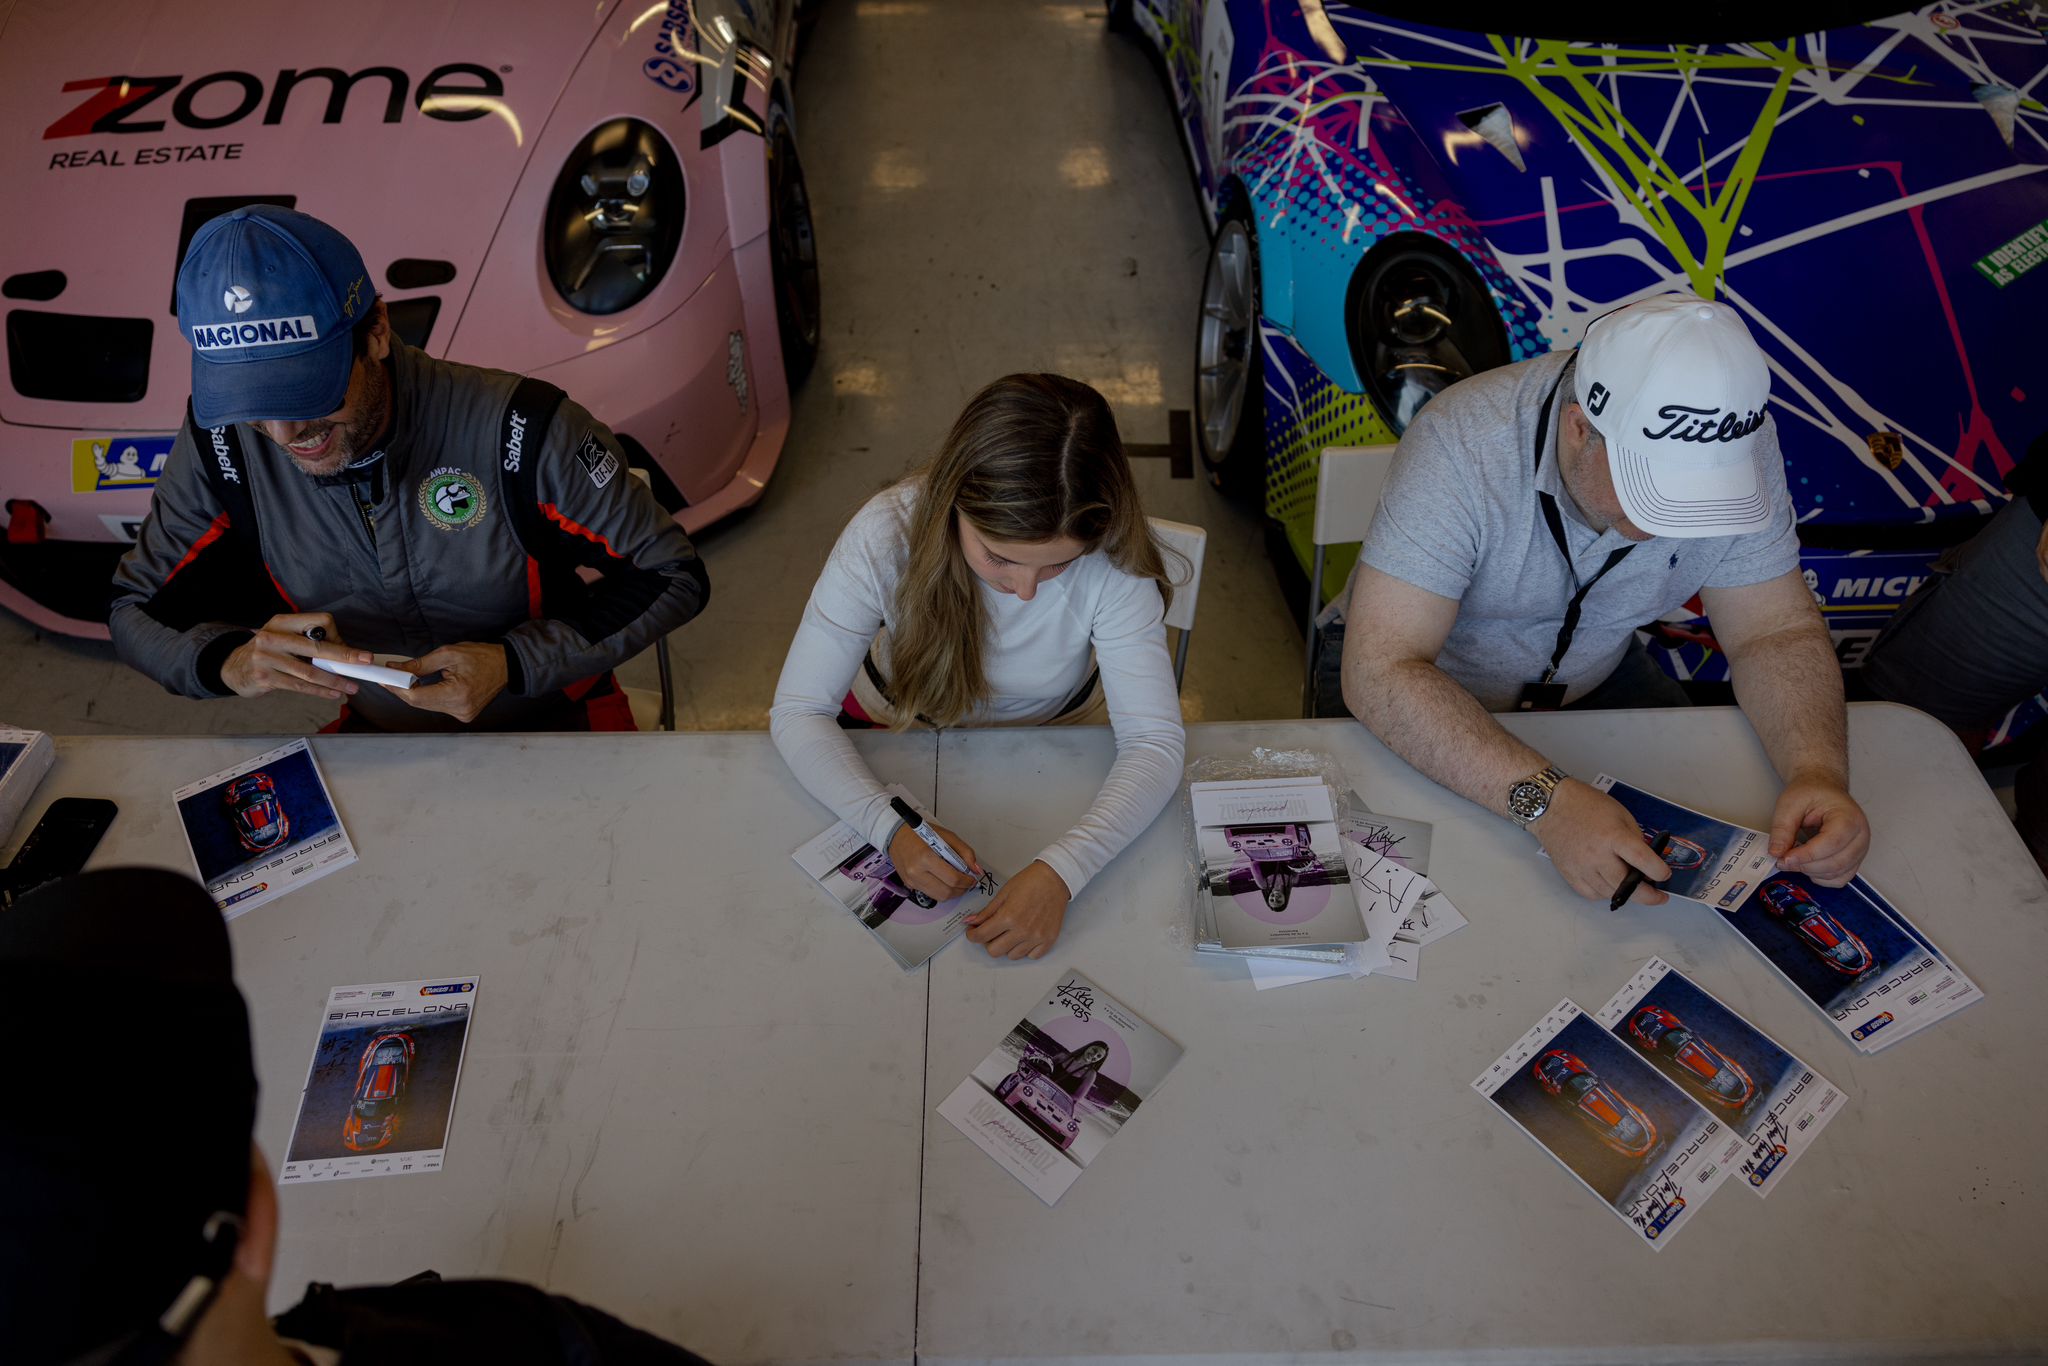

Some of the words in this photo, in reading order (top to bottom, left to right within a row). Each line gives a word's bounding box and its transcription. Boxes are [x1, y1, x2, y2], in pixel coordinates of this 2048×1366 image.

[49, 148, 125, 169] REAL
[134, 143, 243, 165] ESTATE
[194, 317, 313, 348] NACIONAL
[504, 409, 528, 474] Sabelt
[430, 466, 462, 479] ANPAC
[207, 832, 342, 895] BARCELONA
[1696, 831, 1758, 900] BARCELONA
[328, 1002, 469, 1021] BARCELONA
[1060, 998, 1092, 1023] #935
[1833, 957, 1936, 1022] BARCELONA
[1624, 1121, 1721, 1217] BARCELONA
